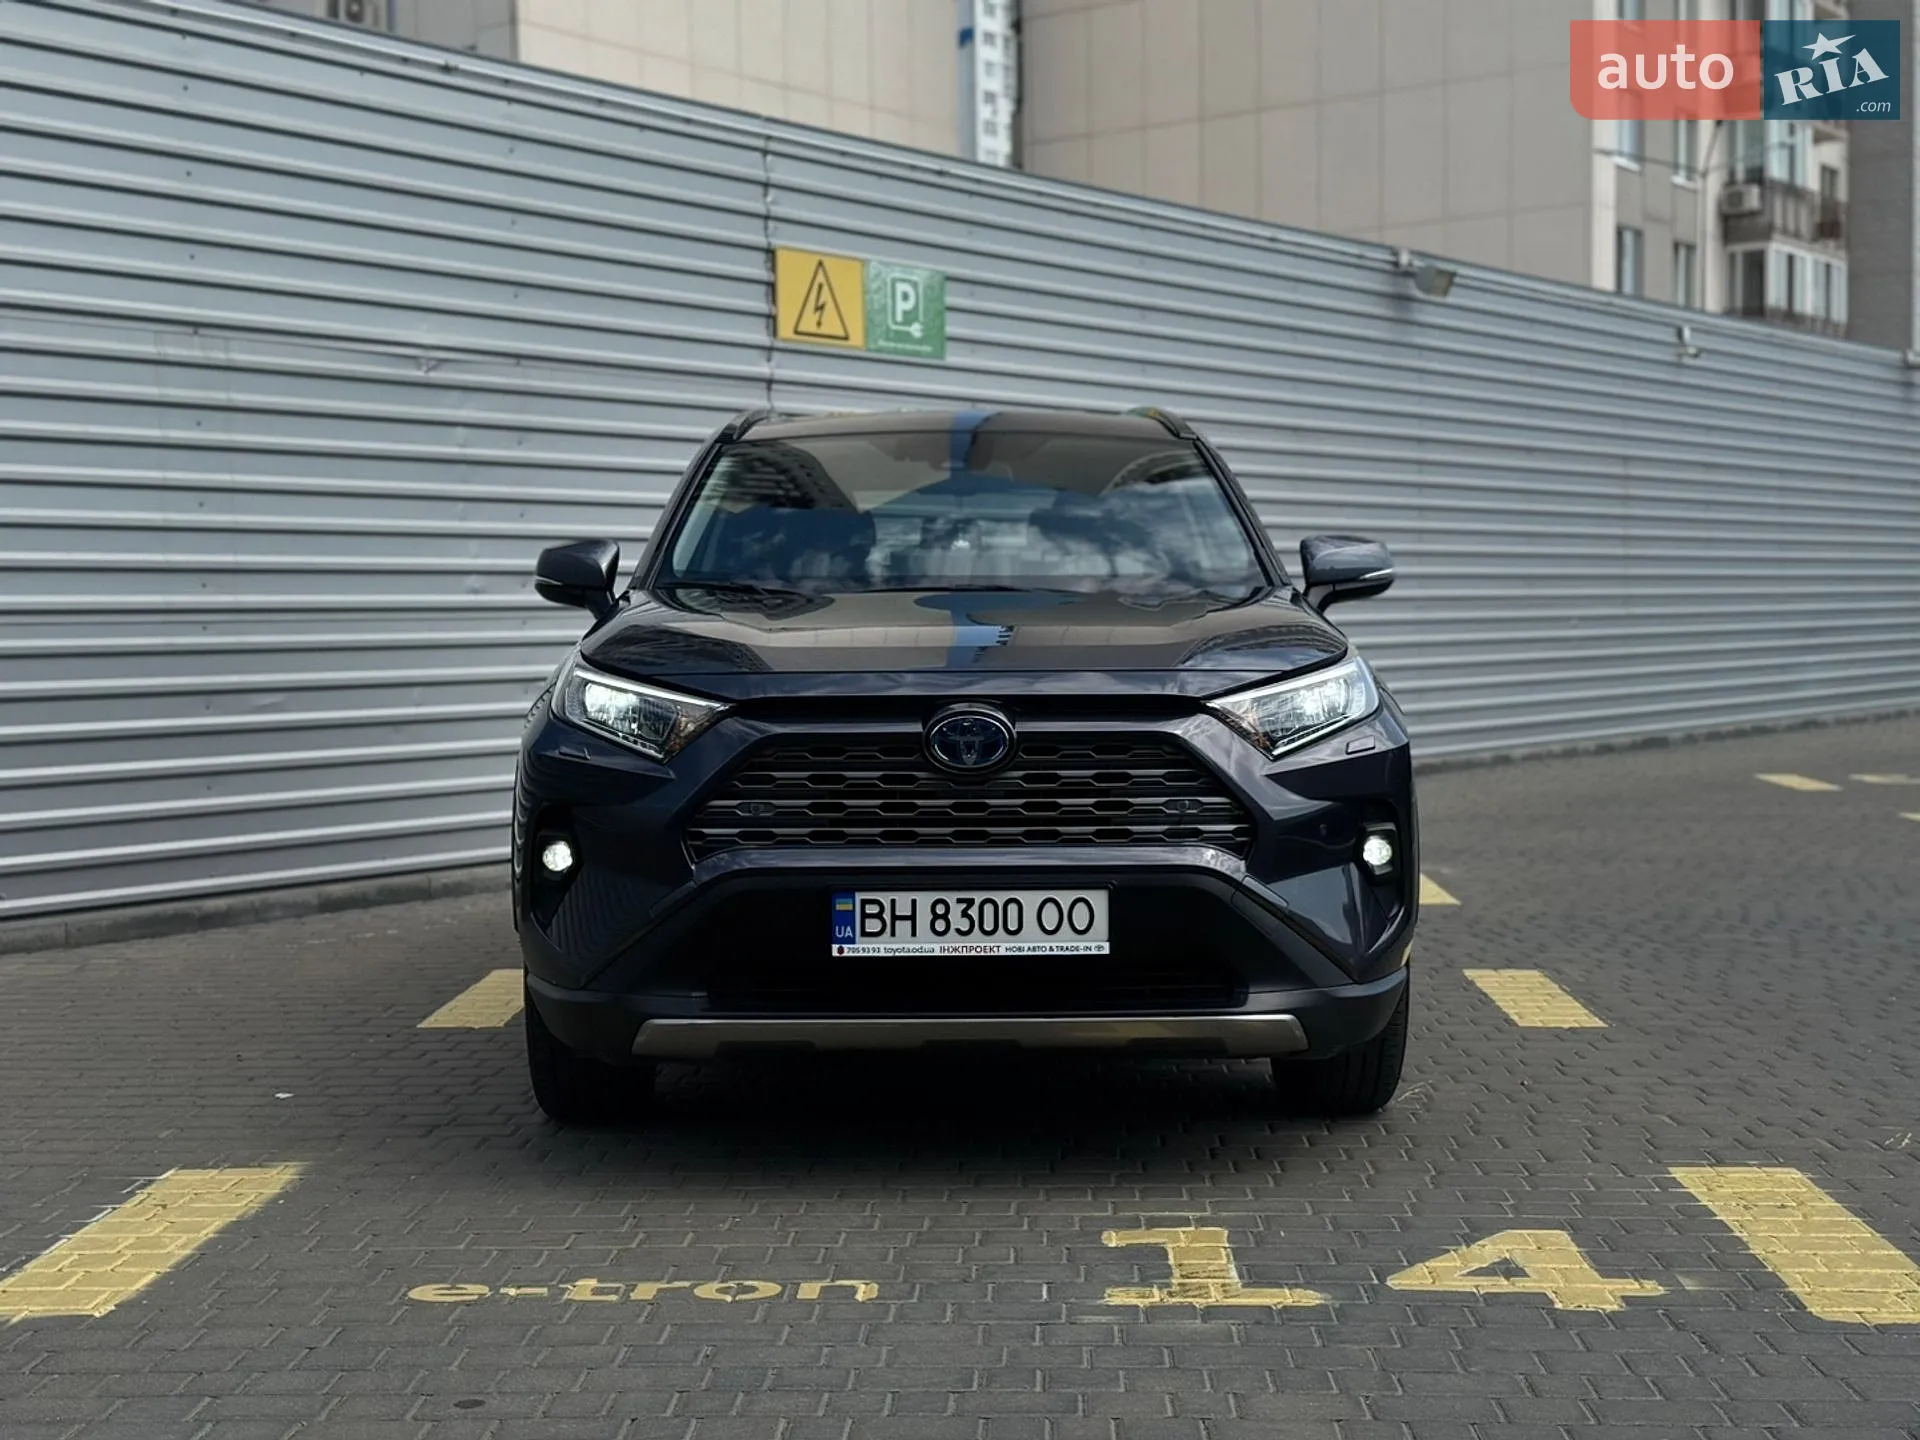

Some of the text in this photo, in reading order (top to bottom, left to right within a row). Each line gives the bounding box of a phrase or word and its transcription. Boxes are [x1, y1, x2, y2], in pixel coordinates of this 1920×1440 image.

[895, 281, 917, 324] P
[835, 925, 854, 938] UA
[860, 898, 918, 938] BH
[929, 897, 1024, 937] 8300
[407, 1278, 880, 1303] e-tron
